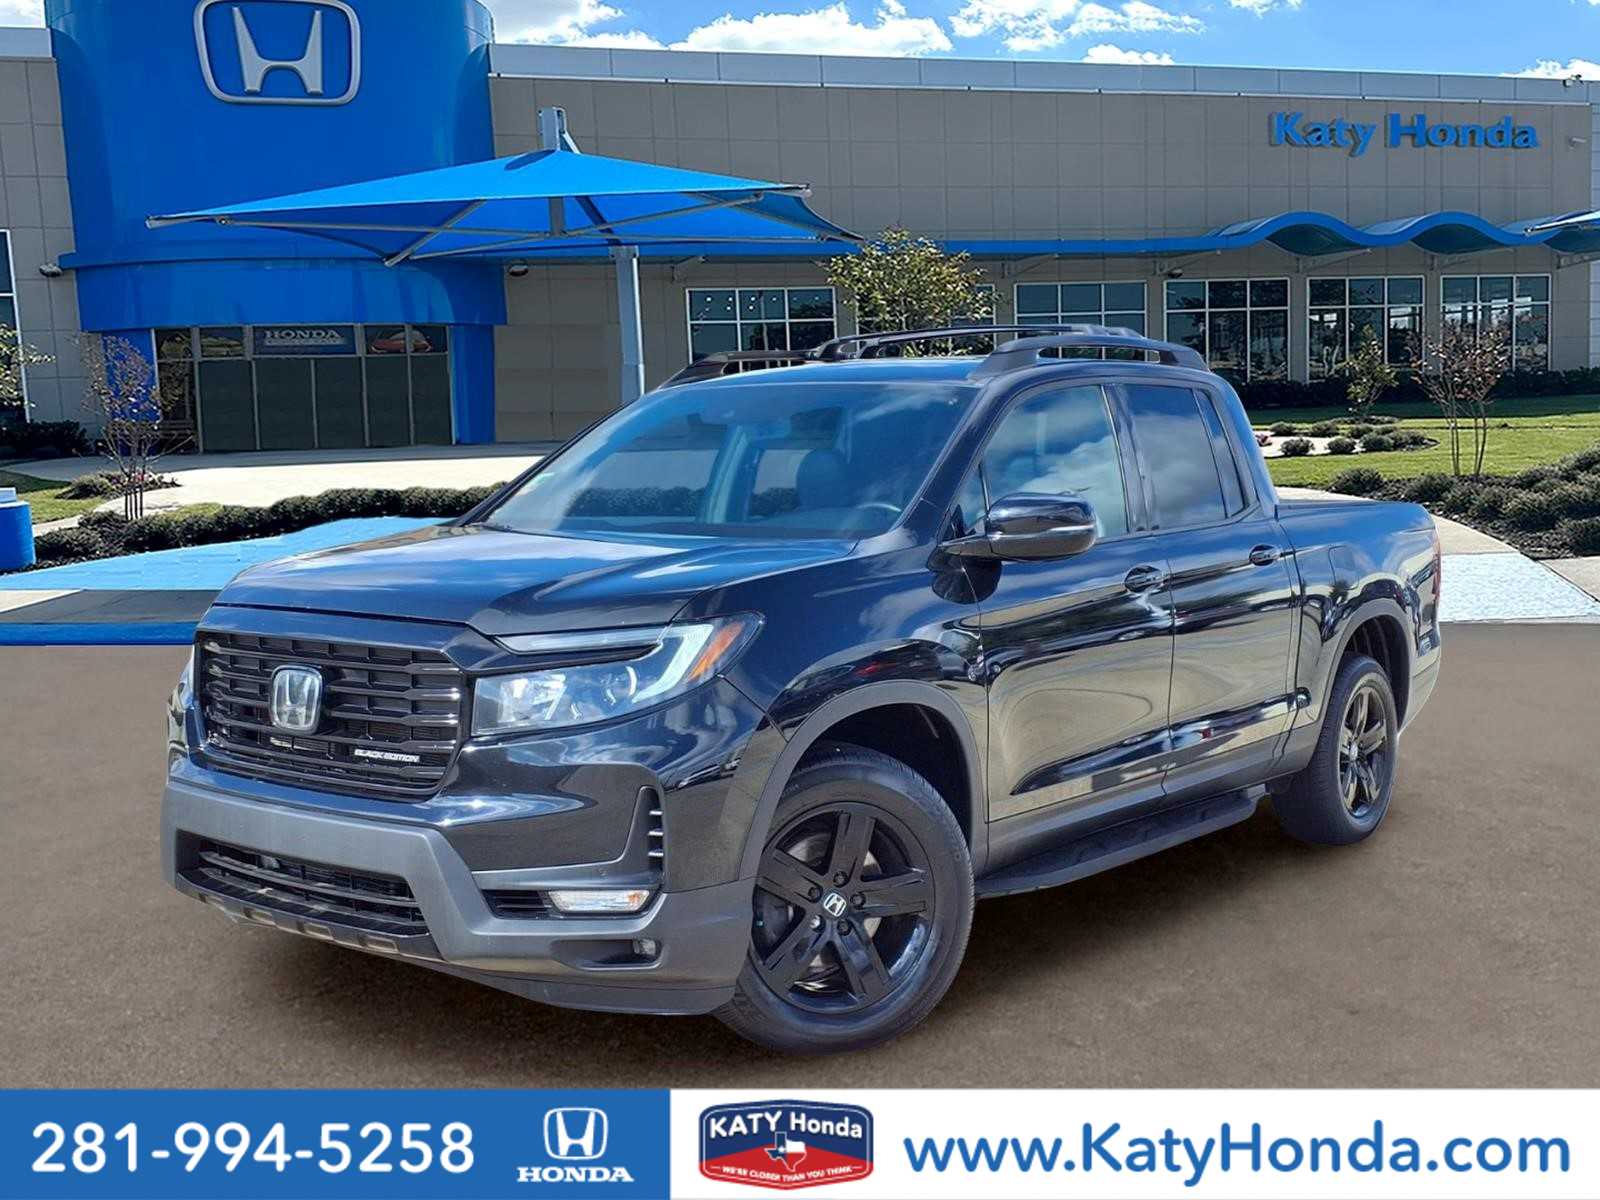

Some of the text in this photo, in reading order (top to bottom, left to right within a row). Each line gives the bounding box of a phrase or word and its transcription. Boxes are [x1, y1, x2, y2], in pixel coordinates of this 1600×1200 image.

[1270, 112, 1540, 158] Katy Honda
[264, 329, 343, 339] HONDA
